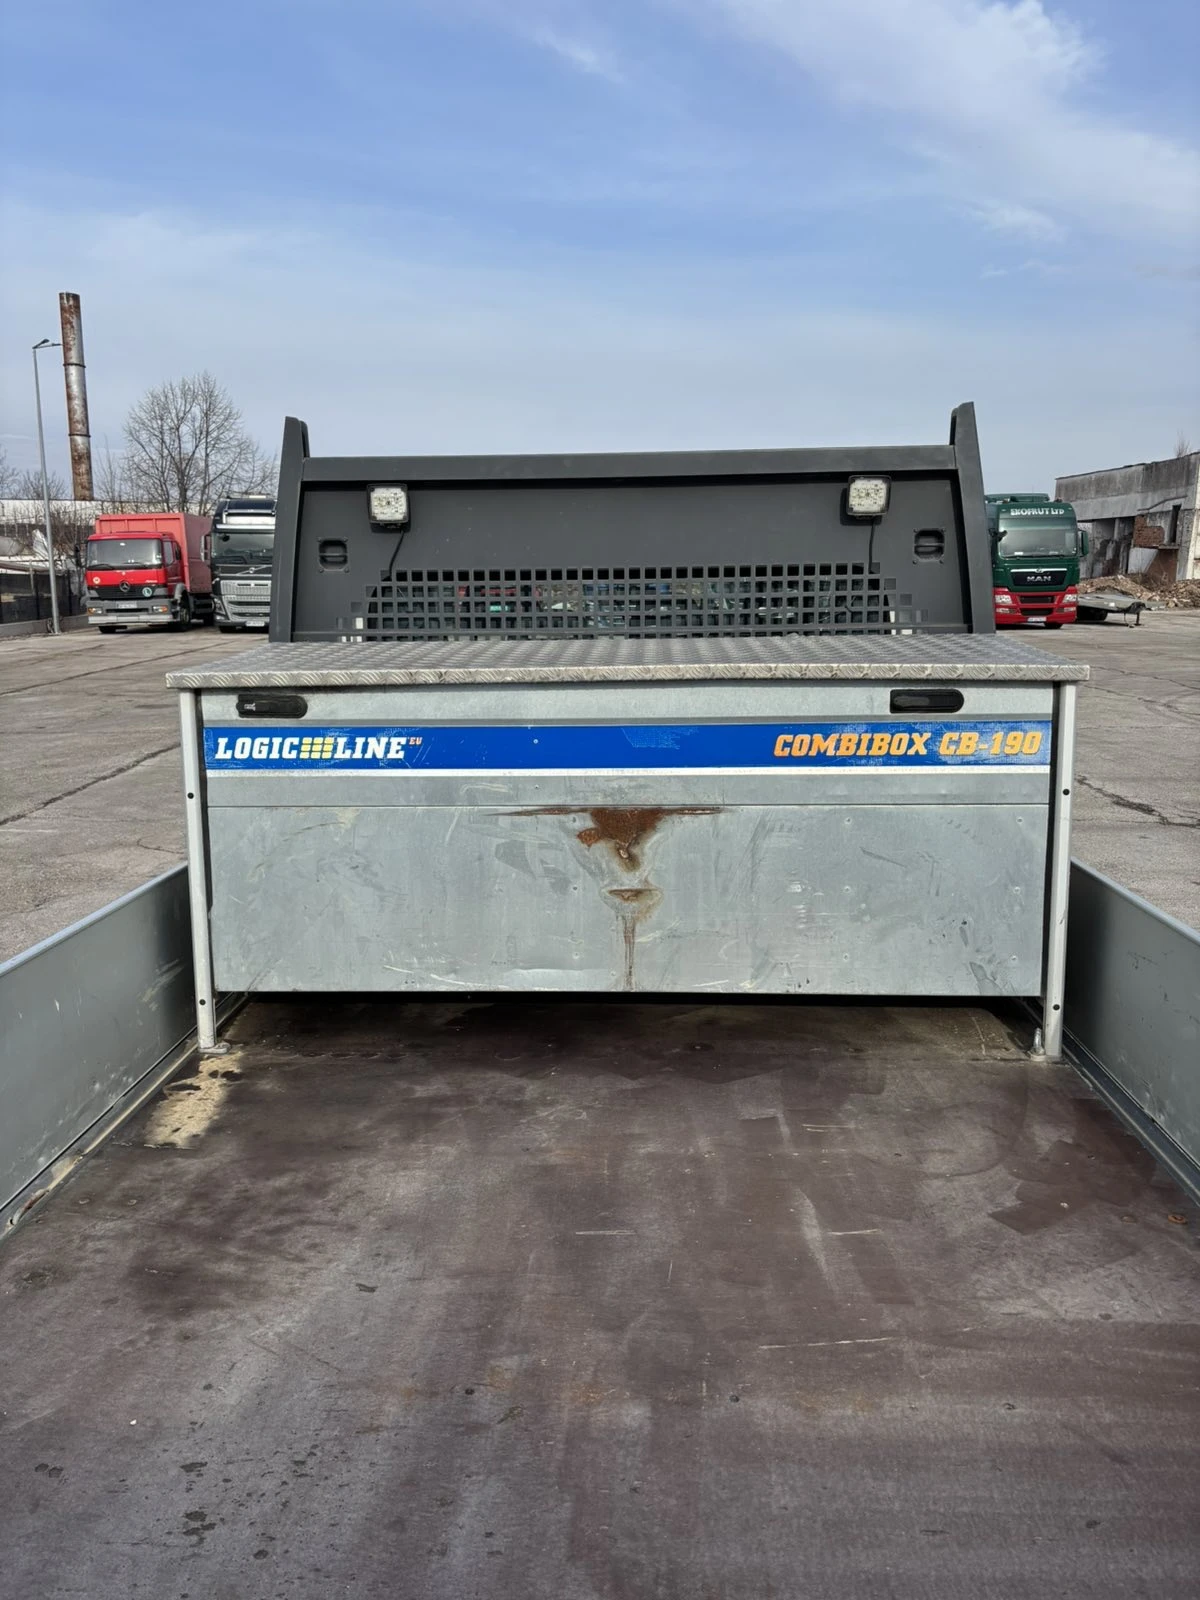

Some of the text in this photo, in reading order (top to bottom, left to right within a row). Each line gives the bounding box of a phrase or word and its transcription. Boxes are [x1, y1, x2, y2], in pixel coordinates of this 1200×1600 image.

[215, 737, 301, 759] LOGIC
[333, 737, 407, 759] LINE
[773, 731, 1043, 757] COMBIBOX CB-190
